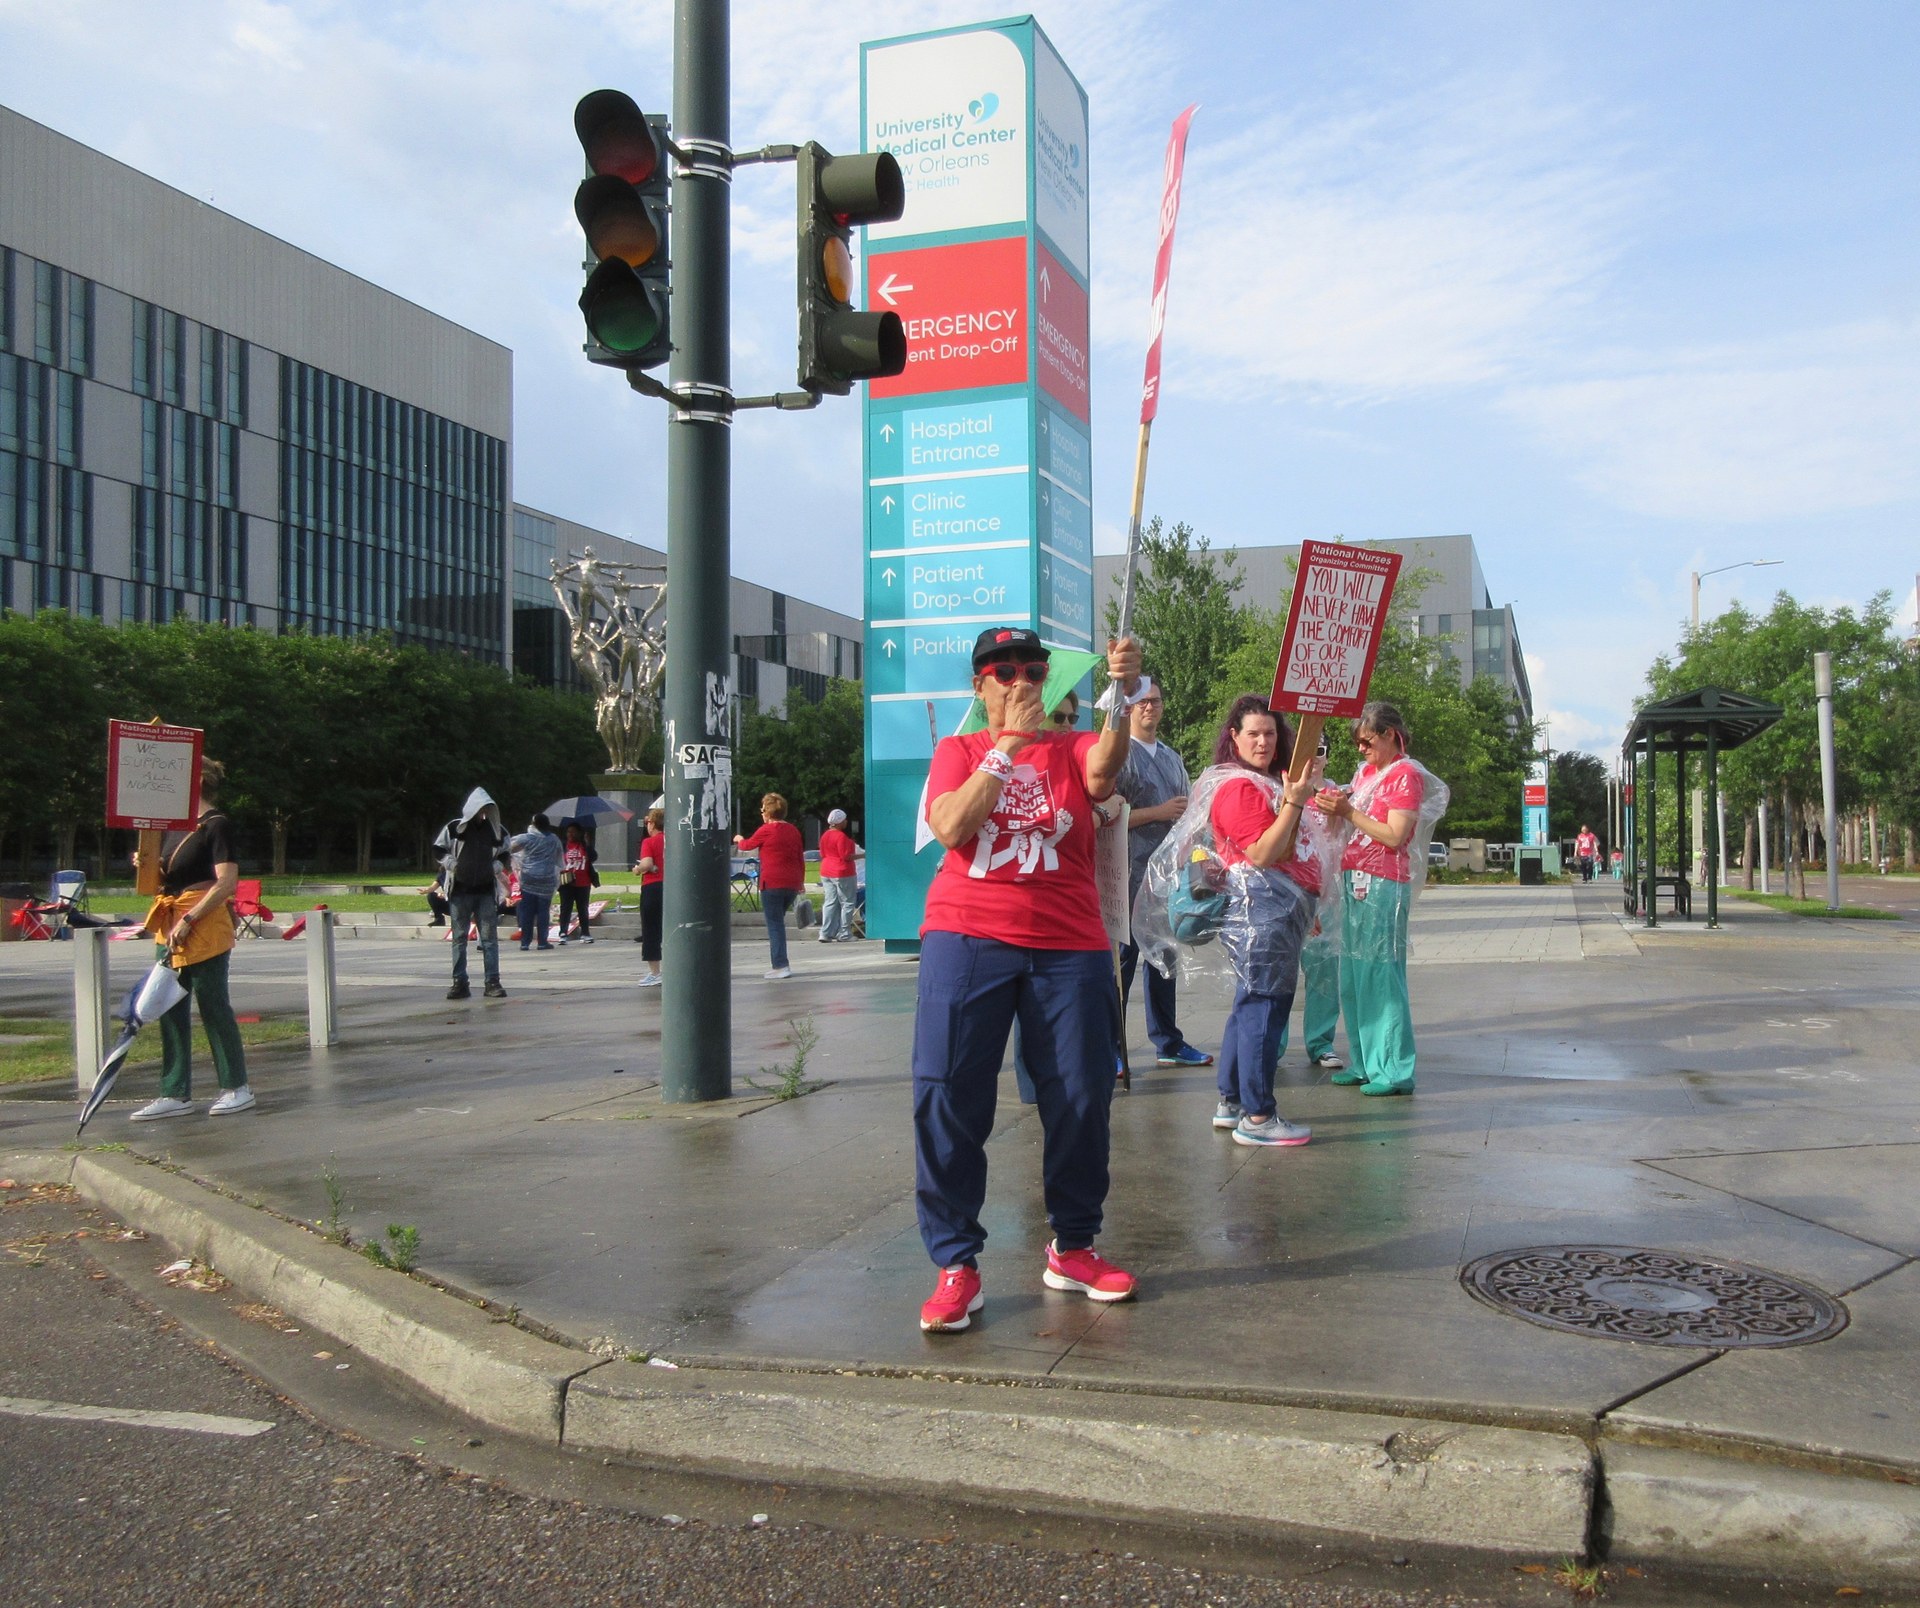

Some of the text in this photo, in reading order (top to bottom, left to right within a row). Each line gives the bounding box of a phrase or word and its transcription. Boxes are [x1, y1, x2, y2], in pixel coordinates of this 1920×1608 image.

[876, 113, 964, 138] University
[876, 128, 1017, 157] Medical Center
[919, 153, 990, 174] Orleans
[917, 175, 960, 191] Health
[901, 309, 1018, 341] ERGENCY
[940, 336, 1019, 363] Drop-Off
[1039, 312, 1086, 371] EMERGENCY
[911, 414, 993, 441] Hospital
[911, 442, 1000, 465] Entrance
[911, 491, 966, 512] Clinic
[912, 517, 1001, 537] Entrance
[1310, 555, 1389, 573] Organizing Committee
[1311, 544, 1392, 565] National Nurses
[912, 563, 985, 584] Patient
[1054, 568, 1079, 596] Patient
[1312, 567, 1377, 603] YOU WILL
[912, 585, 1006, 612] Drop-Off
[1303, 594, 1377, 627] NEVER HAVE
[1300, 620, 1372, 650] THE COMFORT
[913, 636, 974, 656] Parkin
[1295, 643, 1347, 663] OF OUR
[1291, 662, 1348, 680] SILENCE
[120, 723, 194, 736] National Nurses
[137, 743, 158, 755] WE
[120, 755, 187, 770] SUPPORT
[1004, 785, 1044, 802] TRIKE
[1020, 795, 1047, 810] OUR
[993, 803, 1050, 818] ATIENTS
